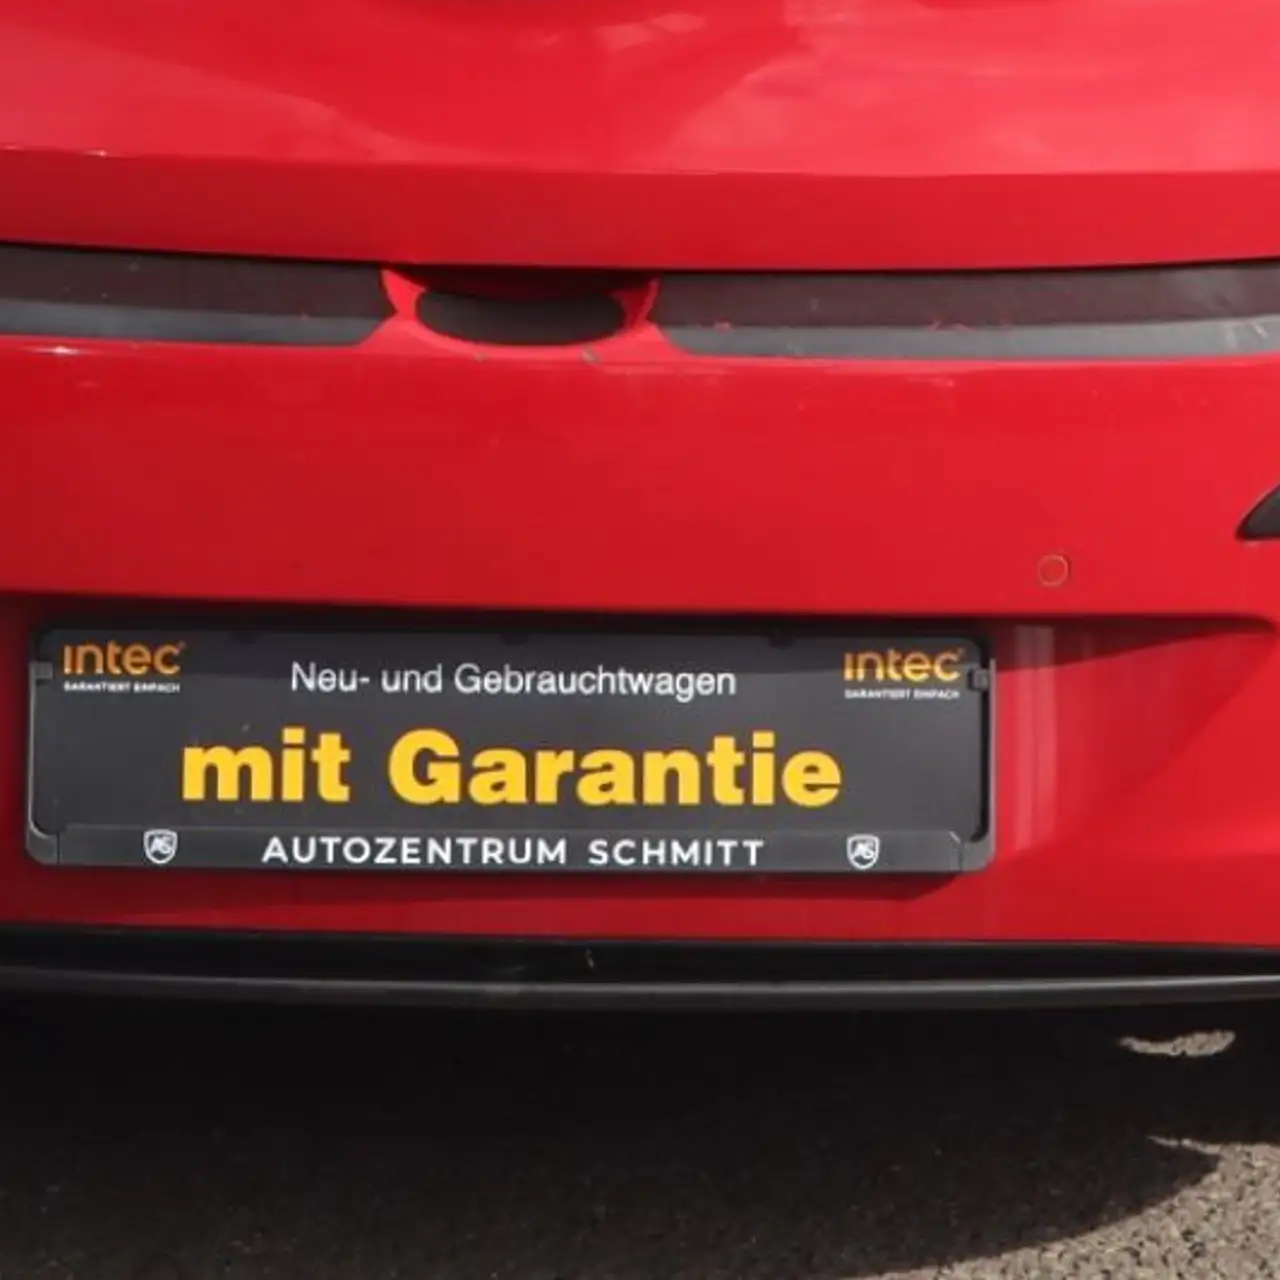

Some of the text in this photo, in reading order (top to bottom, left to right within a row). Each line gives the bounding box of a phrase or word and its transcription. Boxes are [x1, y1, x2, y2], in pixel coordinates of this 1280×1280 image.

[63, 640, 182, 676] intec
[843, 648, 962, 682] intec
[291, 661, 738, 703] Neu- und Gebrauchtwagen
[181, 727, 842, 807] mit Garantie
[261, 834, 764, 867] AUTOZENTRUM SCHMITT
